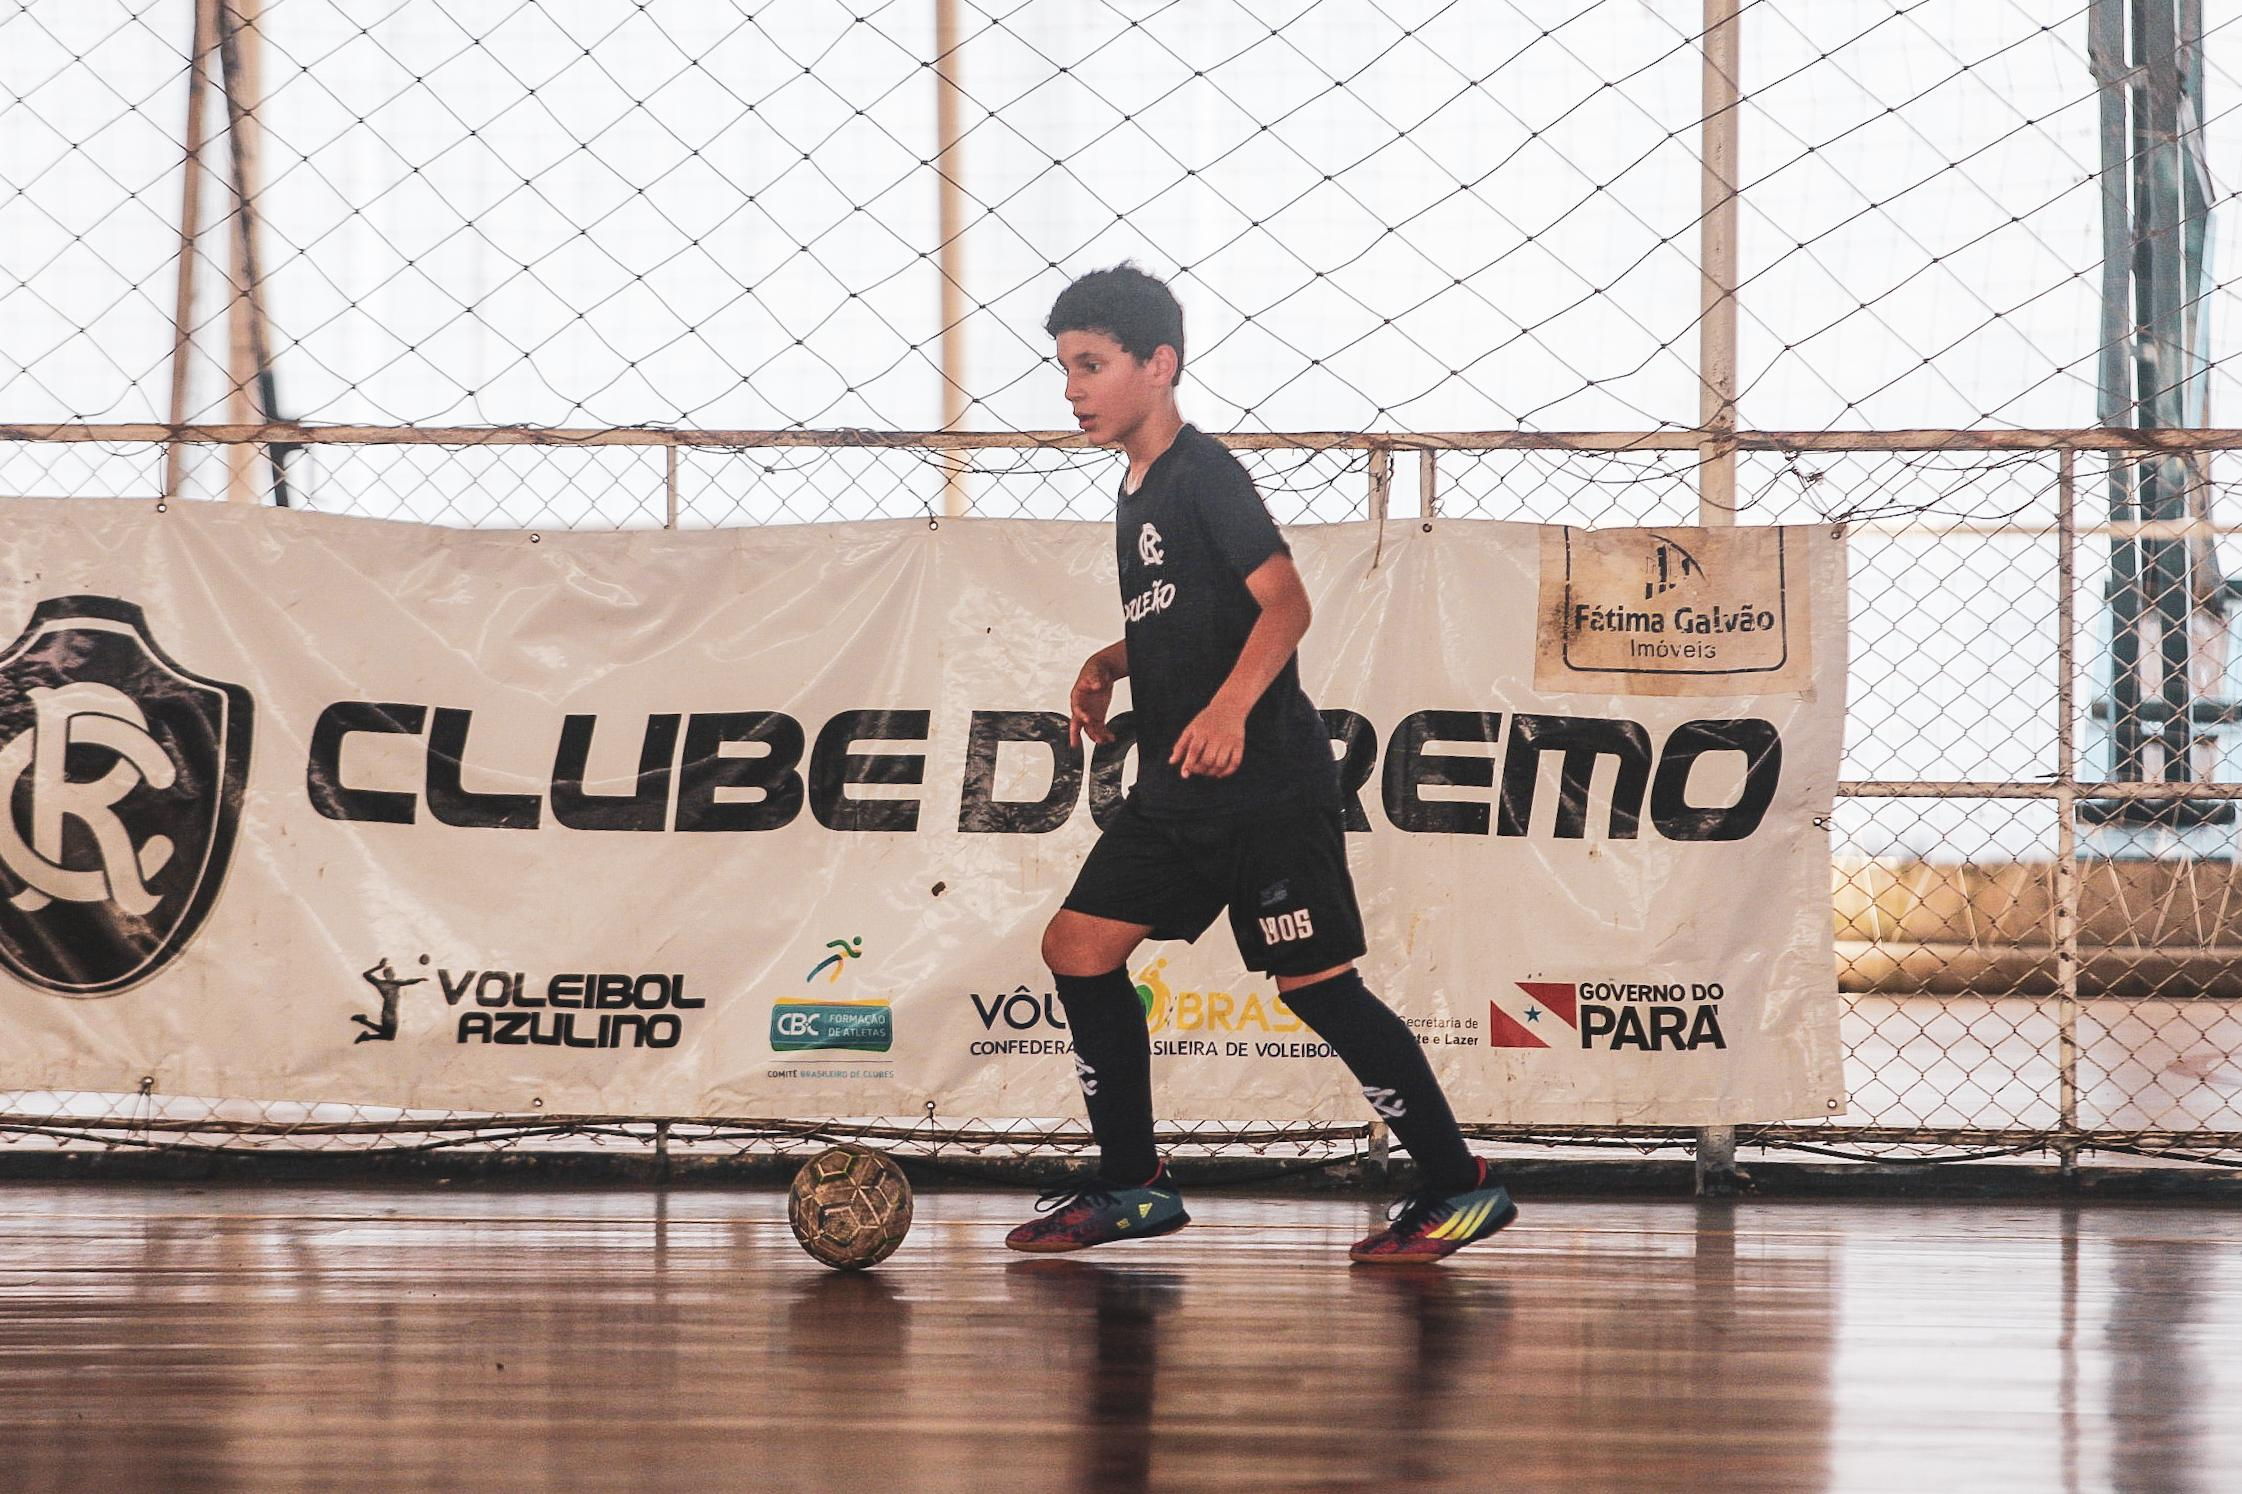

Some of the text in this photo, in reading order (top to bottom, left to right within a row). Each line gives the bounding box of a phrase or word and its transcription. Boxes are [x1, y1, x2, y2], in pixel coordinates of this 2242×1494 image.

[1574, 604, 1775, 634] Fátima Galvão
[1630, 639, 1717, 659] Imóveis
[307, 701, 931, 832] CLUBE
[438, 969, 705, 1009] VOLEIBOL
[1579, 983, 1723, 1002] GOVERNO DO
[829, 1013, 886, 1025] FORMAÇÃO
[970, 985, 1312, 1032] VÔL BRAS
[457, 1011, 682, 1048] AZULINO
[777, 1012, 820, 1036] CBC
[828, 1028, 886, 1037] DE ATLETAS
[1465, 1017, 1478, 1029] de
[1581, 1003, 1727, 1051] PARÁ
[970, 1039, 1075, 1056] CONFEDERA
[1226, 1042, 1249, 1057] DE
[1433, 1036, 1440, 1044] e
[1445, 1034, 1479, 1046] Lazer
